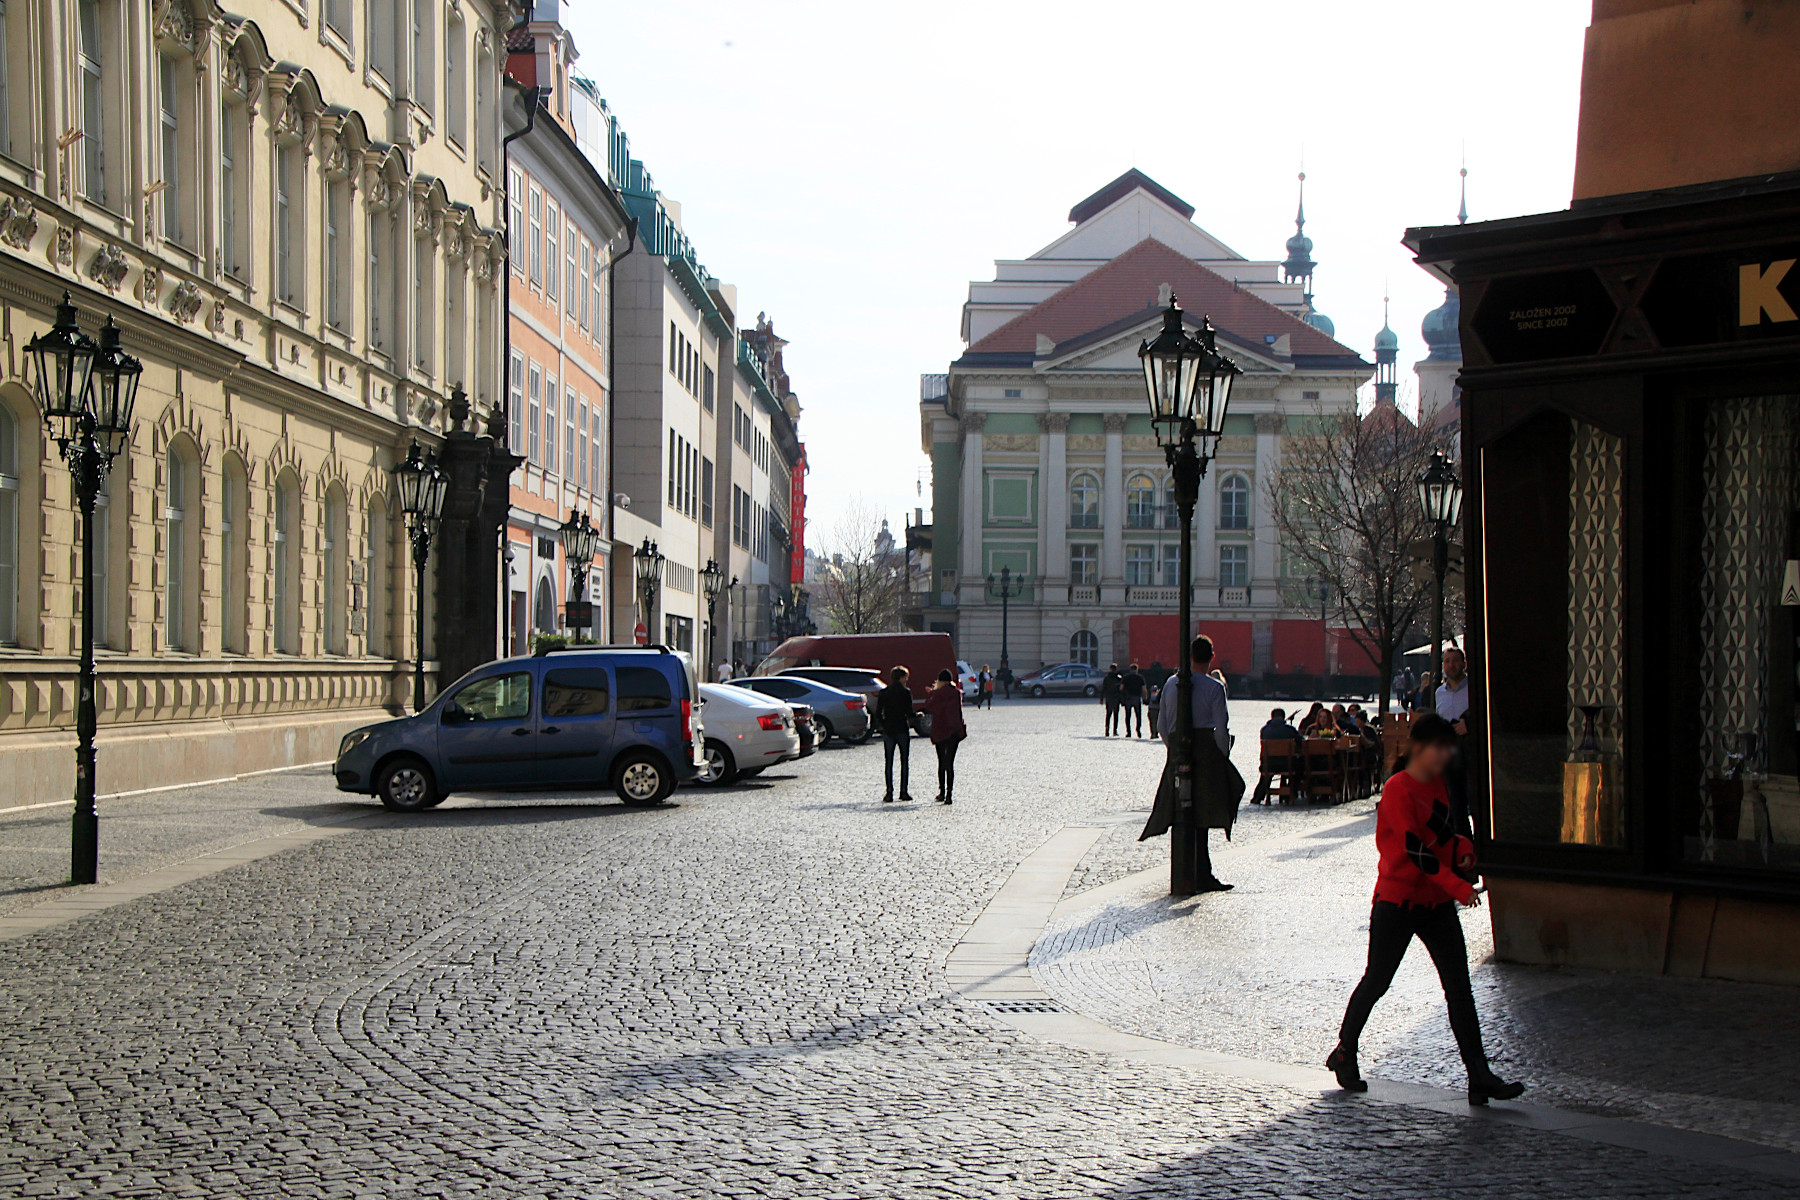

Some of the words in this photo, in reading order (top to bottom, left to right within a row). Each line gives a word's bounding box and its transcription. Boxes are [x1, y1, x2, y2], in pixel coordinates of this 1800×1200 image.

[1739, 258, 1799, 327] K
[1509, 307, 1552, 320] ZALOŽEN
[1553, 304, 1577, 316] 2002
[1517, 320, 1544, 331] SINCE
[1545, 317, 1568, 328] 2002
